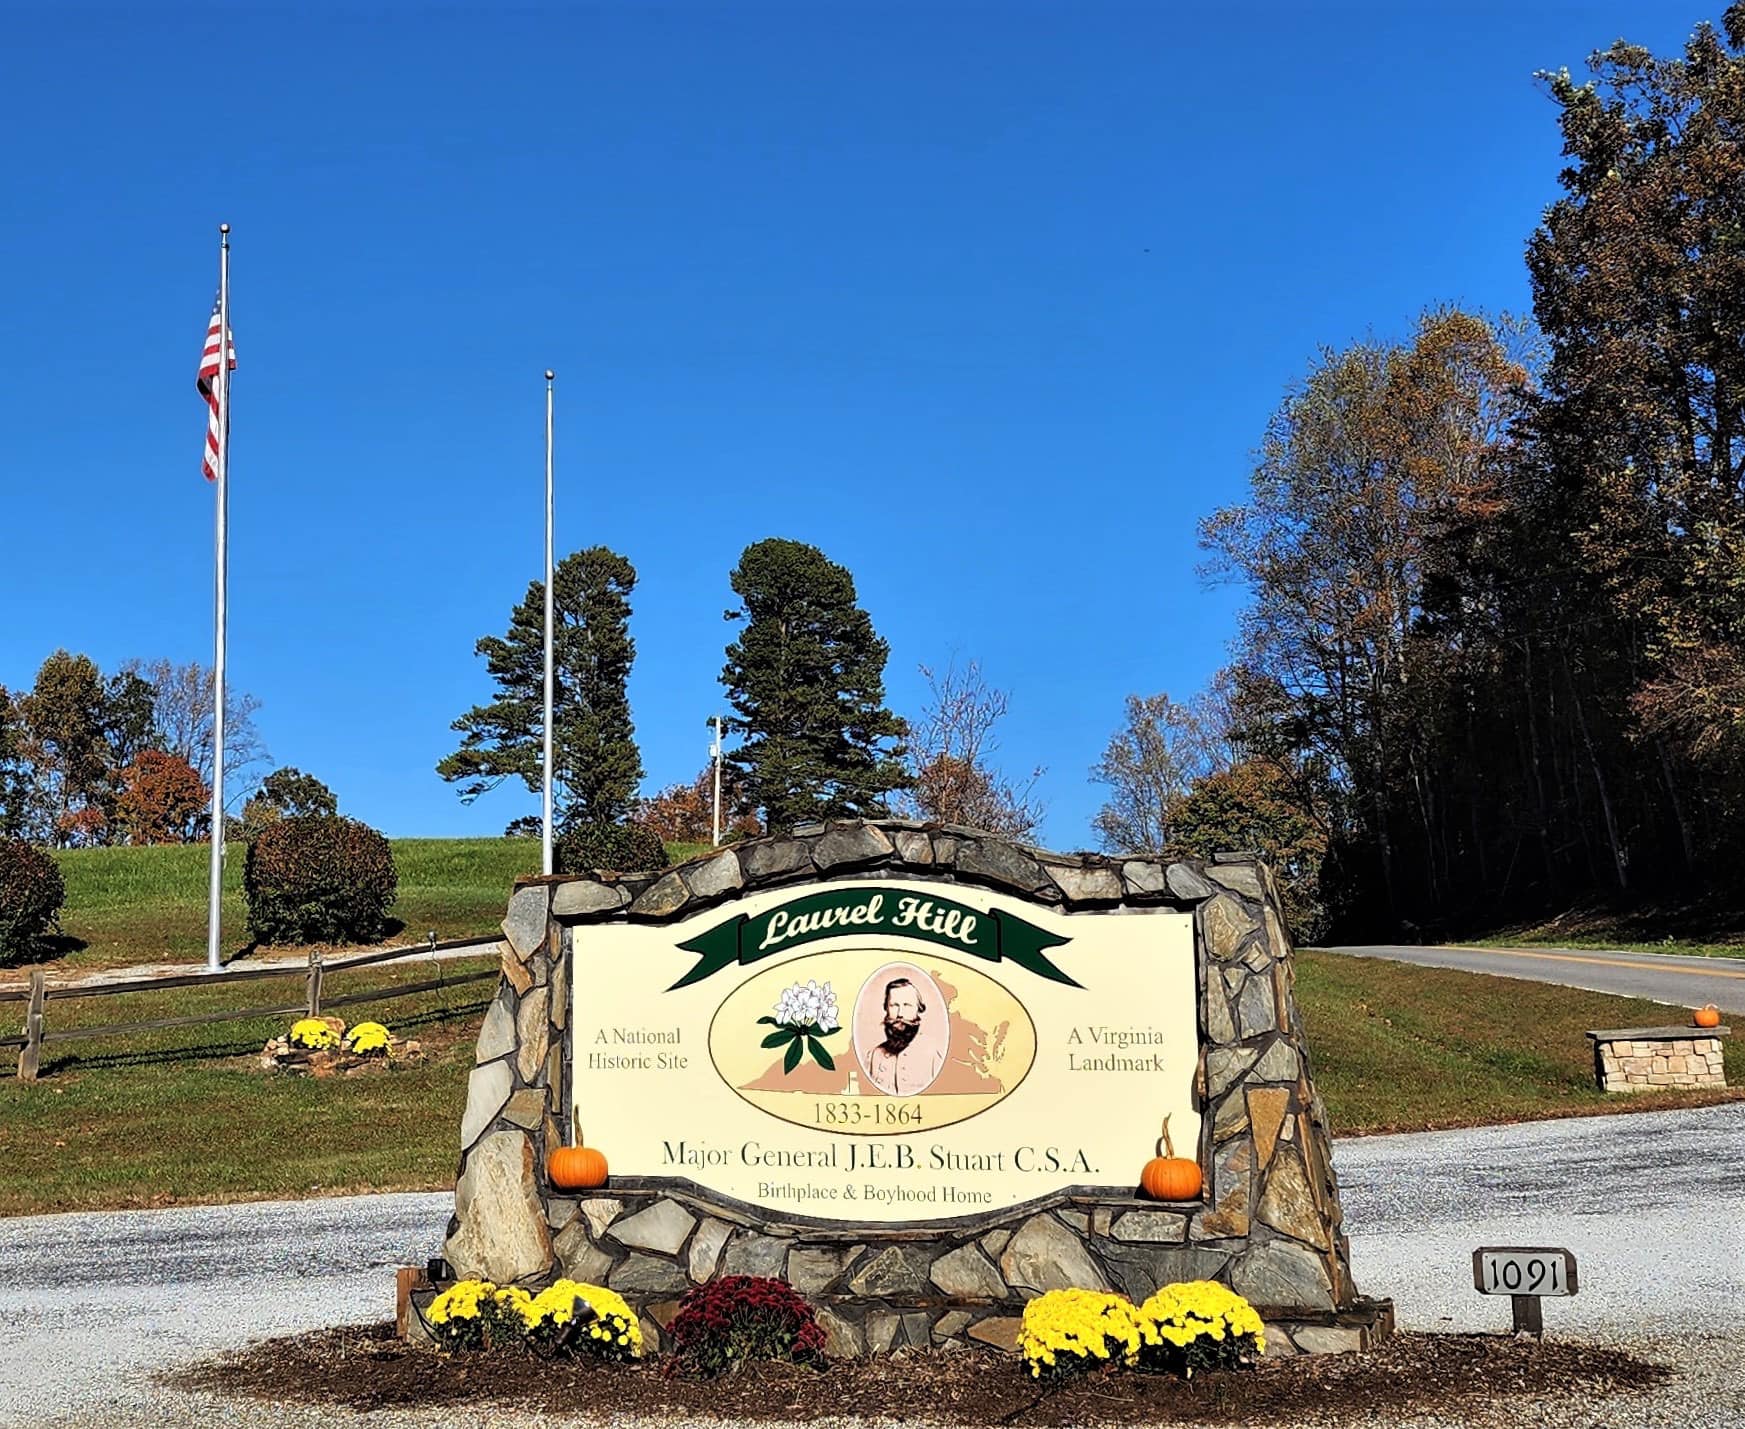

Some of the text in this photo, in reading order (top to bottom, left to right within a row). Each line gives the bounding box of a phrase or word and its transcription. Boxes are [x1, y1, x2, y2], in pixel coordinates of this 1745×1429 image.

[759, 895, 979, 949] Laurel Hill
[595, 1026, 682, 1045] A National
[1068, 1026, 1164, 1049] A Virginia
[588, 1052, 688, 1070] Historic Site
[1069, 1053, 1165, 1072] Landmark
[814, 1103, 923, 1125] 1833-1864
[660, 1140, 1100, 1173] Major General J.E.B. Stuart C.S.A.
[757, 1182, 992, 1206] Birthplace & Boyhood Home
[1491, 1258, 1559, 1292] 1091
